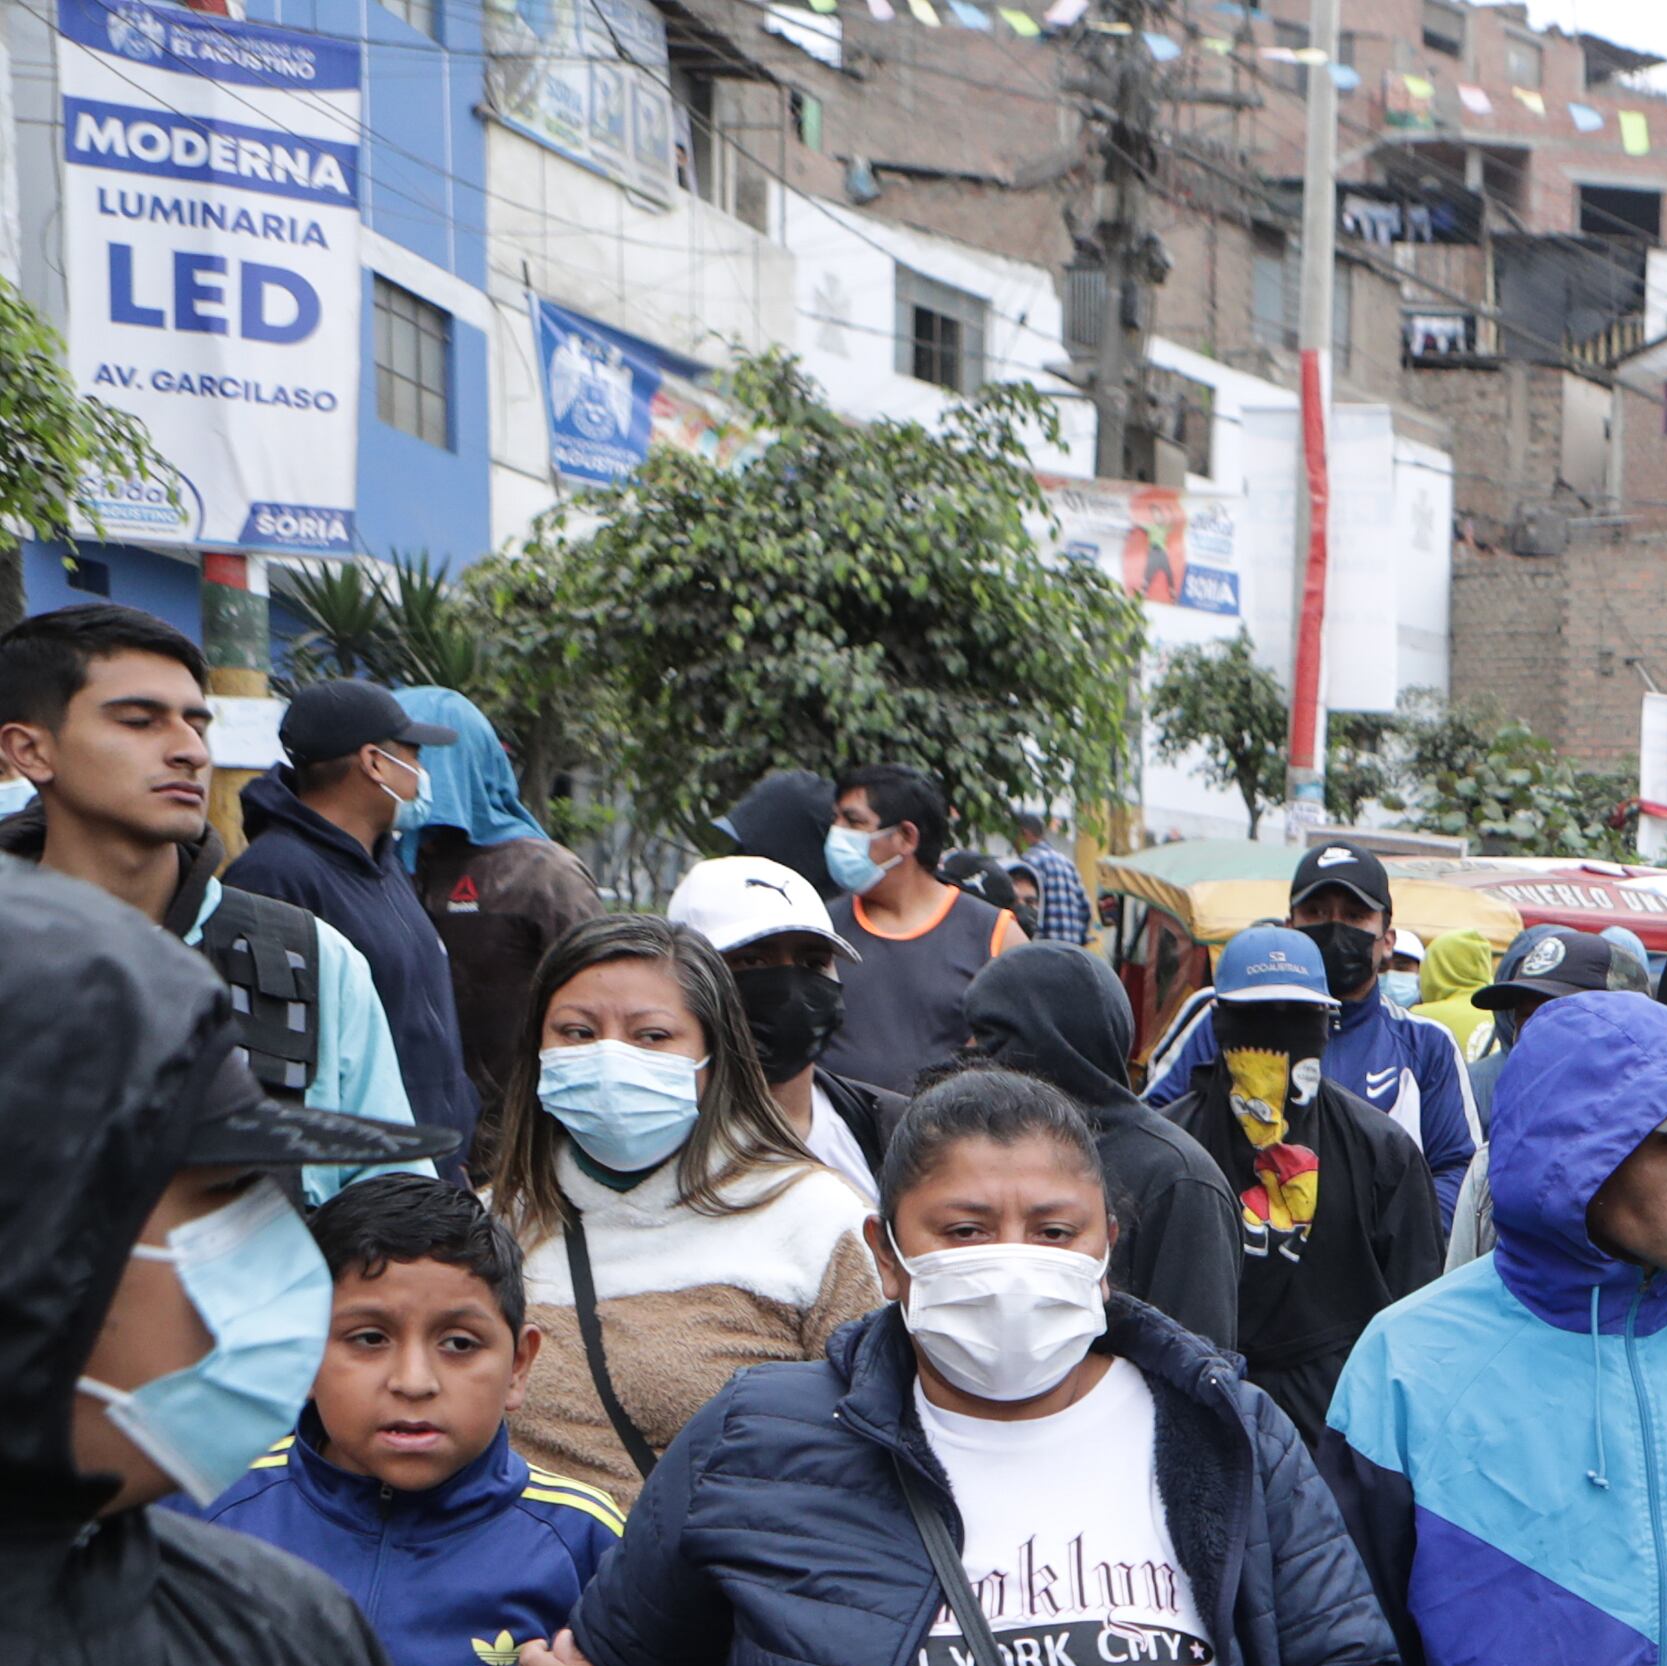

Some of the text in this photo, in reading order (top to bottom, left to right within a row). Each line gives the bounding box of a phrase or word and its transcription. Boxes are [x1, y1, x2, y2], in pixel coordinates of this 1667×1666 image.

[199, 46, 316, 80] AGUSTINO
[74, 112, 350, 195] MODERNA
[97, 187, 330, 250] LUMINARIA
[107, 241, 322, 345] LED
[94, 363, 338, 412] AV. GARCILASO
[255, 513, 350, 541] SORIA
[1502, 884, 1614, 910] PUEBLO
[1097, 1629, 1182, 1664] CITY
